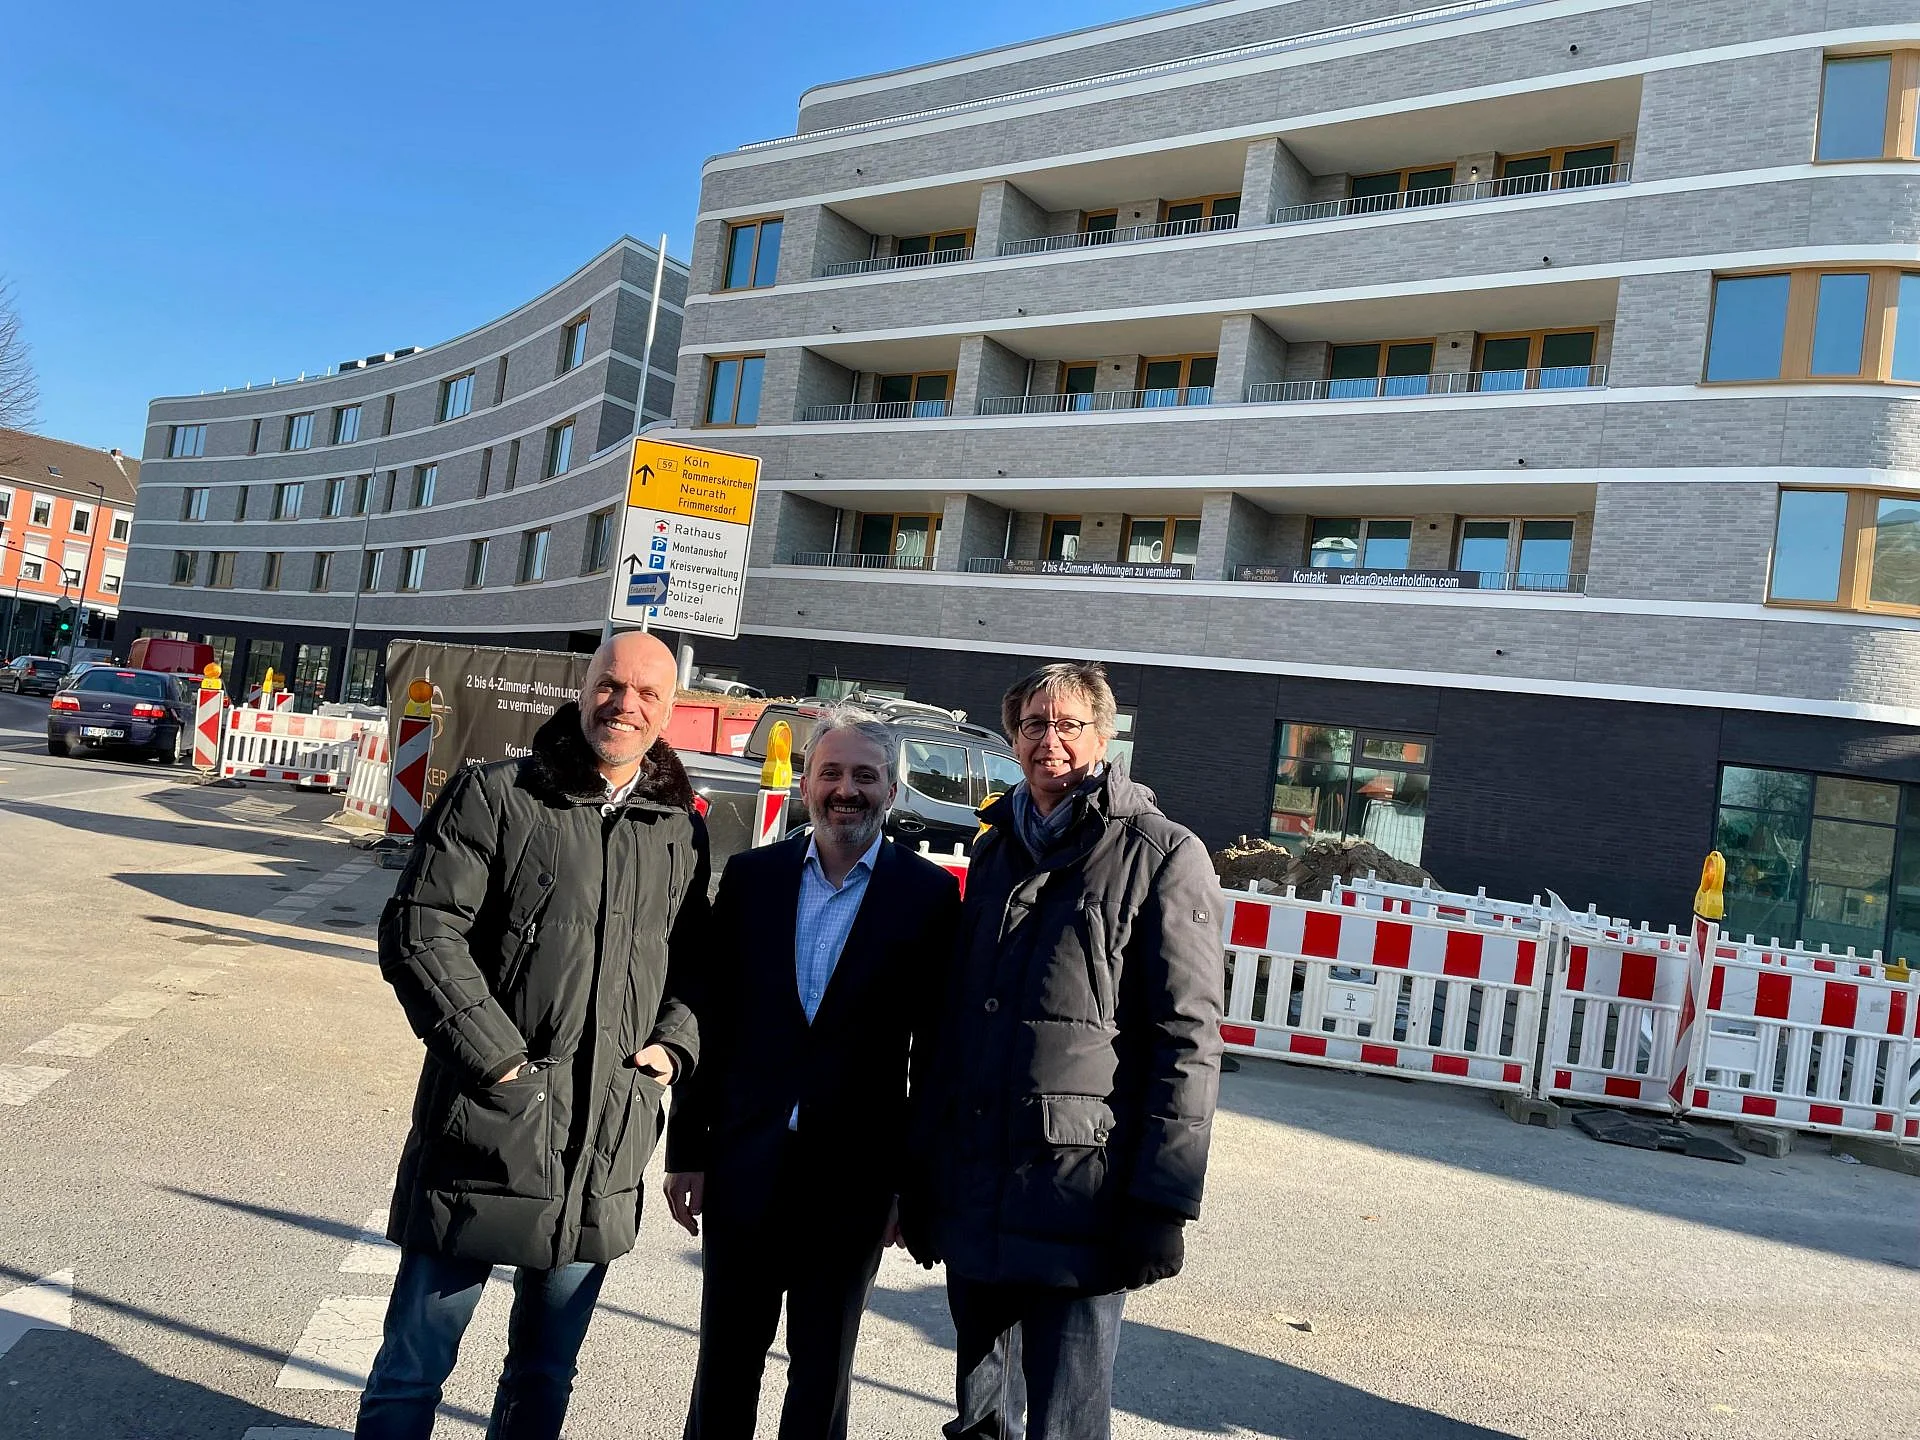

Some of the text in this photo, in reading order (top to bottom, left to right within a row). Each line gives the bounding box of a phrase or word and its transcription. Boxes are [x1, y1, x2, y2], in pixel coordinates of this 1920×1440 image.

[662, 460, 673, 470] 59
[683, 455, 710, 469] Köln
[682, 469, 753, 490] Rommerskirchen
[680, 483, 726, 500] Neurath
[678, 497, 737, 516] Frimmersdorf
[674, 524, 721, 541] Rathaus
[672, 541, 728, 560] Montanushof
[651, 556, 662, 567] P
[670, 560, 739, 581] Kreisverwaltung
[1041, 562, 1182, 579] 2 bis 4-Zimmer-Wohnungen zu vermieten
[1292, 570, 1329, 584] Kontakt:
[669, 576, 739, 597] Amtsgericht
[663, 606, 724, 625] Coens-Galerie
[466, 674, 581, 702] 2 bis 4-Zimmer-Wohnung
[497, 698, 555, 716] zu vermieten
[504, 742, 533, 758] Konta
